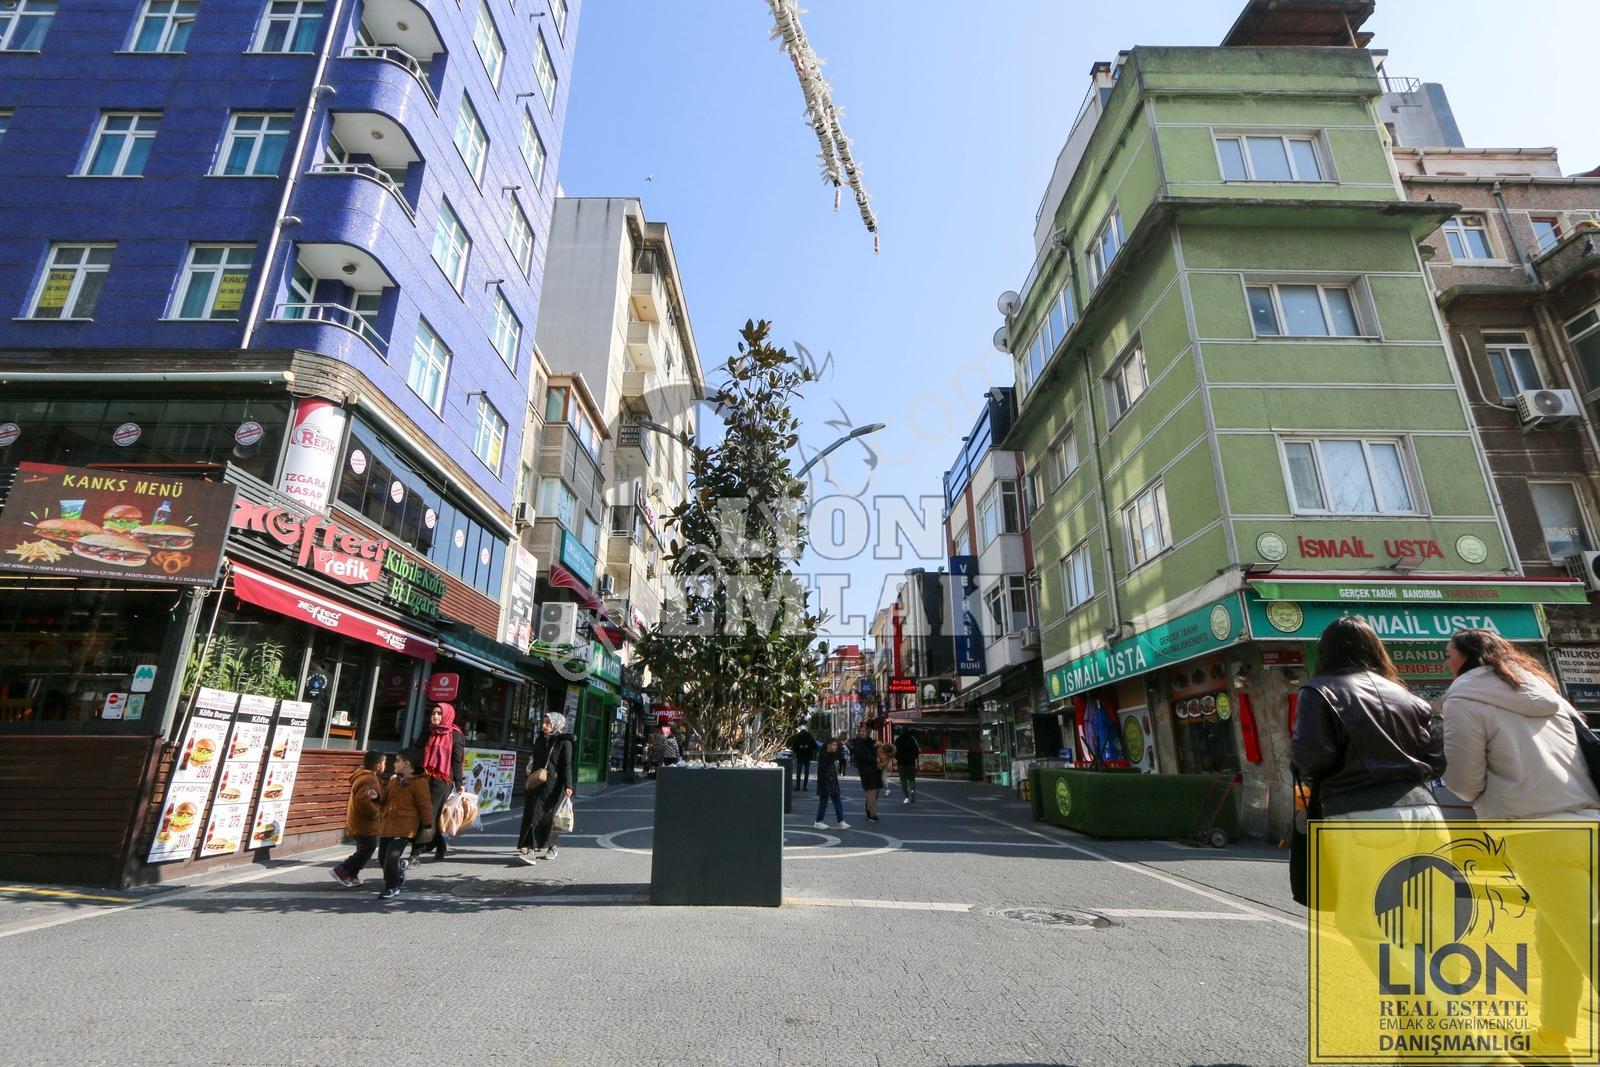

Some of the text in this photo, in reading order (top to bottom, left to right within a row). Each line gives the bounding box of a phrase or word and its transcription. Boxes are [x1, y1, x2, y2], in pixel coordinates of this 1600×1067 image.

[63, 474, 184, 498] KANKS MENÜ
[285, 472, 326, 491] IZGARA
[285, 485, 323, 500] KASAP
[1298, 536, 1445, 558] İSMAİL USTA
[324, 557, 369, 580] refik
[384, 547, 409, 577] Kilo
[389, 577, 404, 601] Et
[1340, 588, 1371, 600] GERÇEK
[1372, 587, 1397, 598] TARİHİ
[1402, 588, 1443, 599] BANDIRMA
[960, 564, 974, 661] VELHASIL
[1433, 615, 1501, 635] USTA
[960, 662, 980, 670] RUHİ
[1063, 645, 1147, 693] İSMAİL USTA
[199, 709, 214, 718] Köfte
[214, 711, 231, 721] Burger
[251, 716, 270, 724] Köfte
